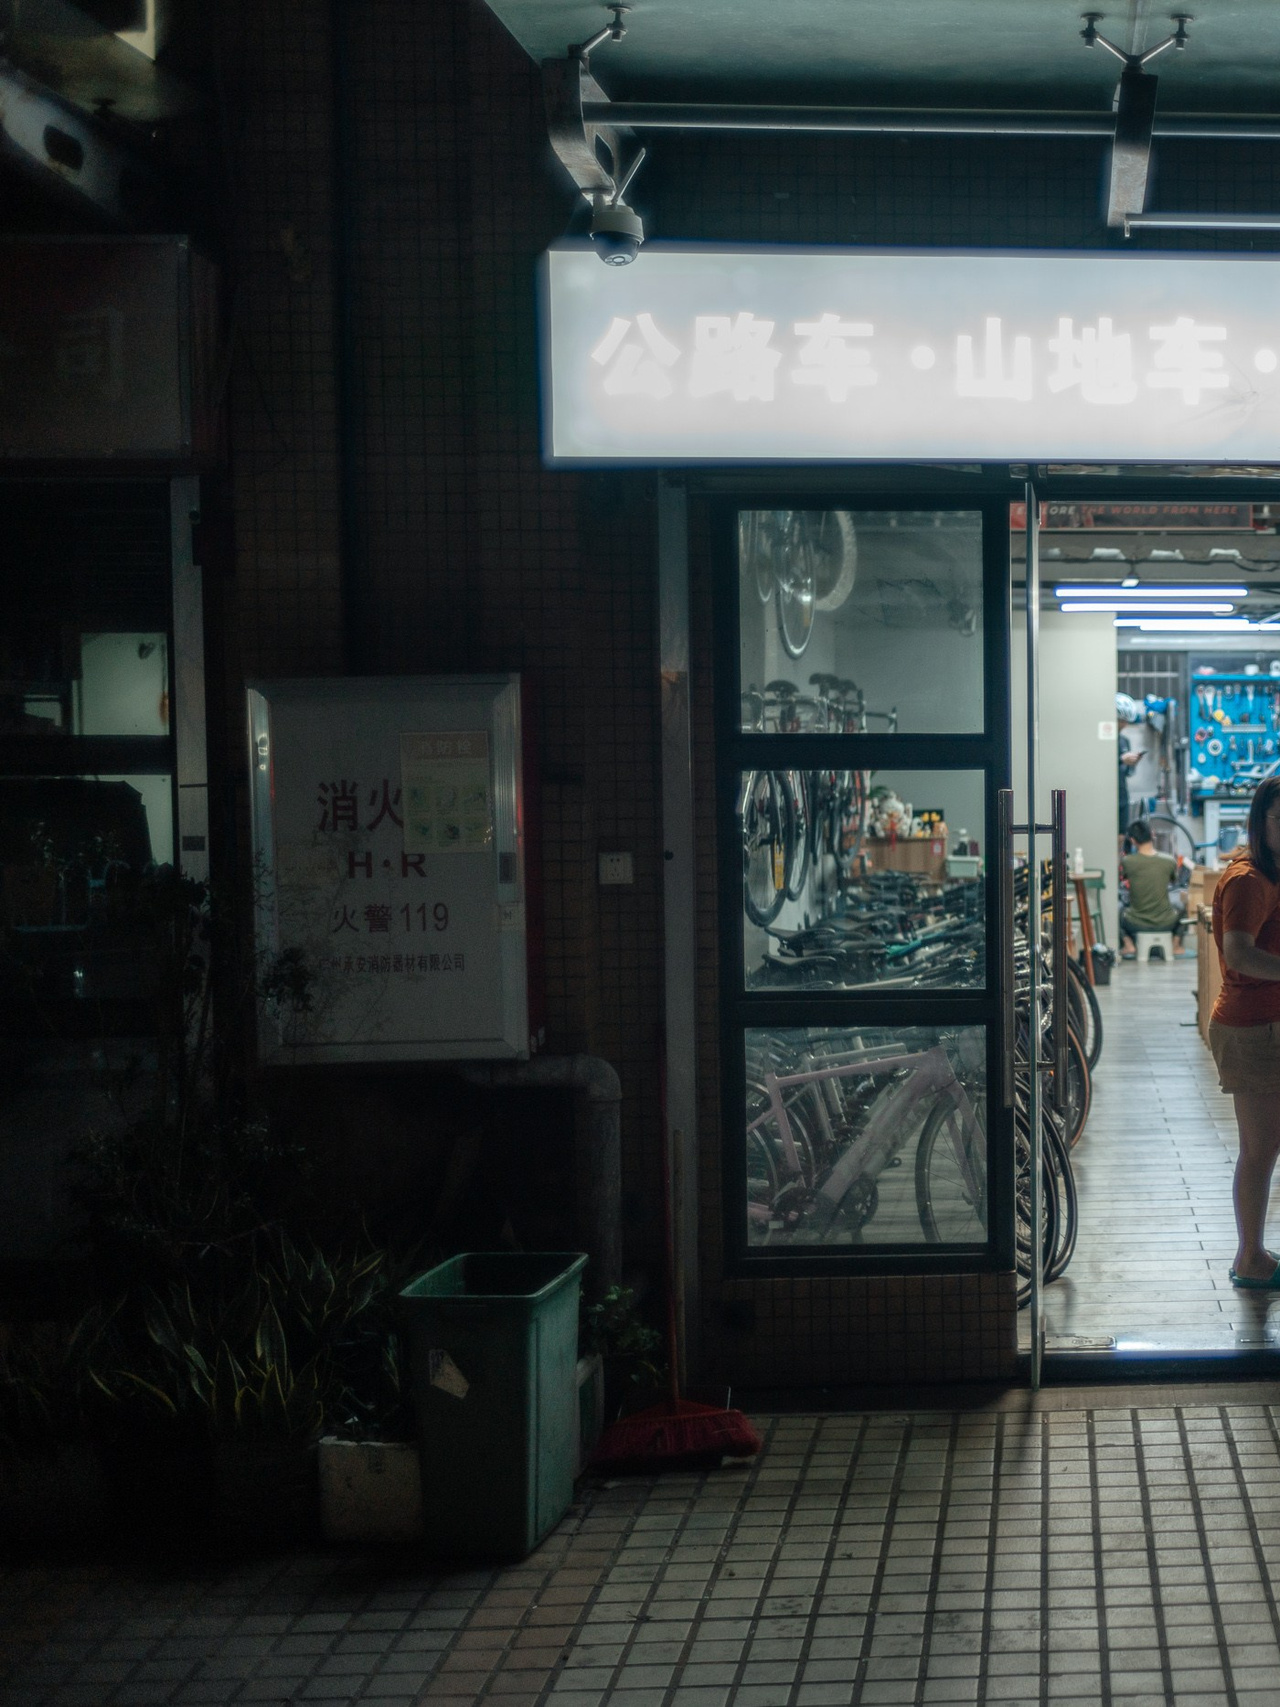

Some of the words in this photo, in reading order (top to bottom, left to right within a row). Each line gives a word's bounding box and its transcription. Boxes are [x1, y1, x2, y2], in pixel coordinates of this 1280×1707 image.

[1081, 506, 1105, 515] THE
[1111, 506, 1158, 515] WORLD
[1163, 506, 1199, 515] FROM
[1204, 506, 1238, 515] HERE
